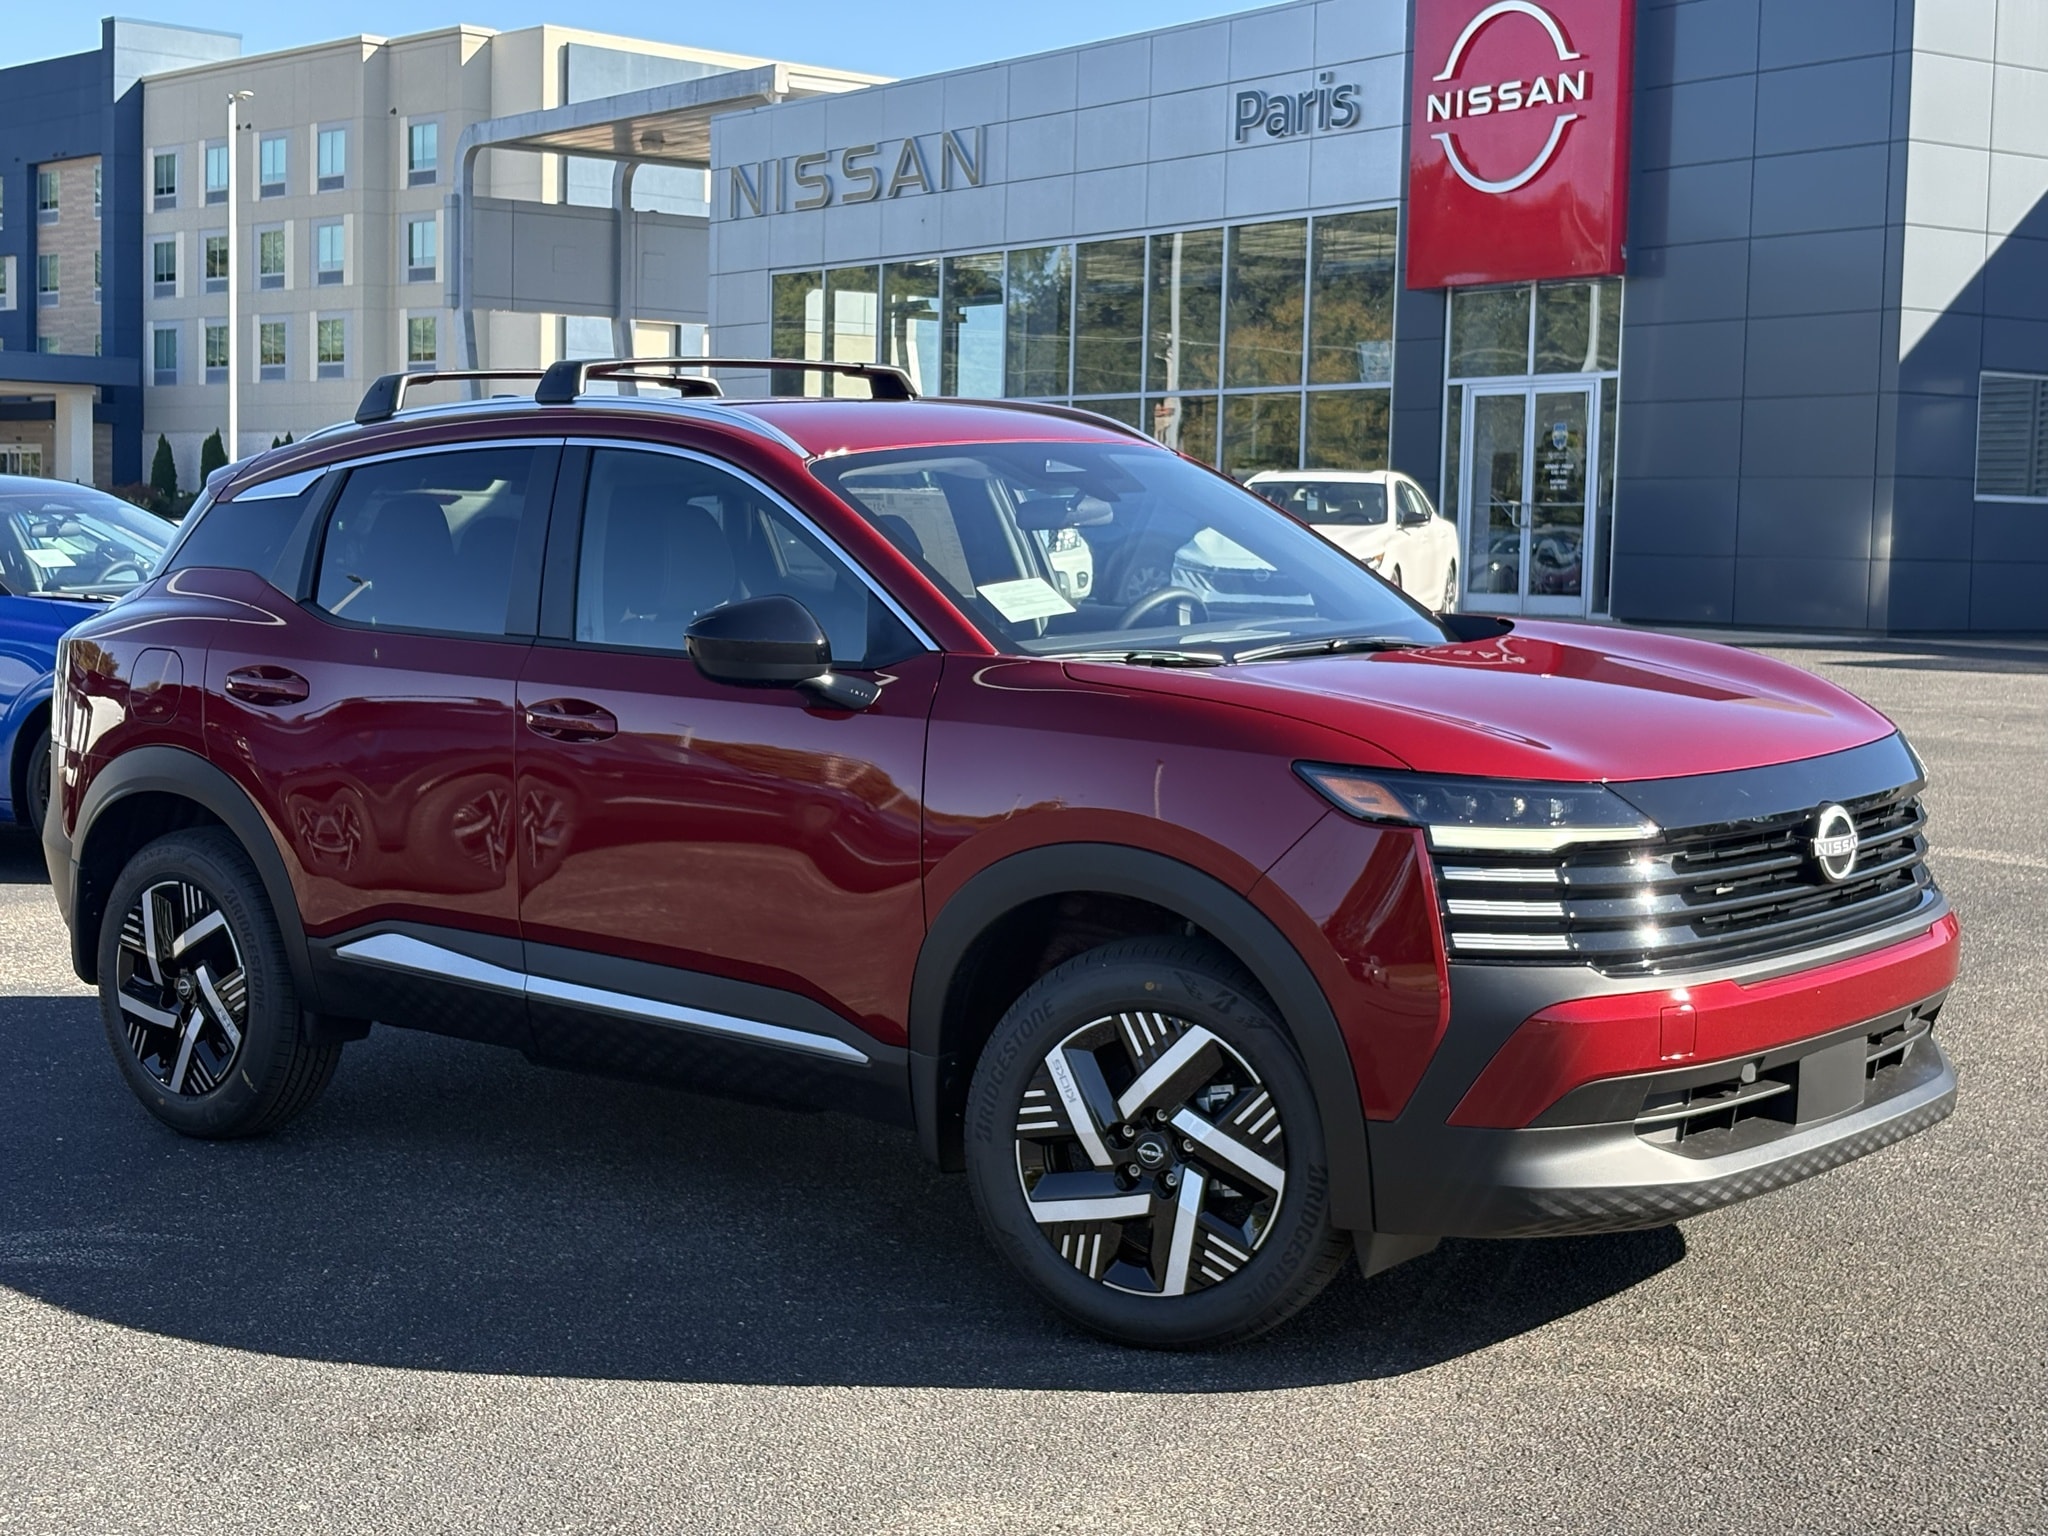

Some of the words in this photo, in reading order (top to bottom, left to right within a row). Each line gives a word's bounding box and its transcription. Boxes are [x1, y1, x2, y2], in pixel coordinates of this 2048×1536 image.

[1235, 71, 1359, 142] Paris
[1426, 70, 1585, 122] NISSAN
[730, 125, 983, 220] NISSAN
[1814, 833, 1858, 857] NISSAN
[1051, 1058, 1077, 1103] KICKS
